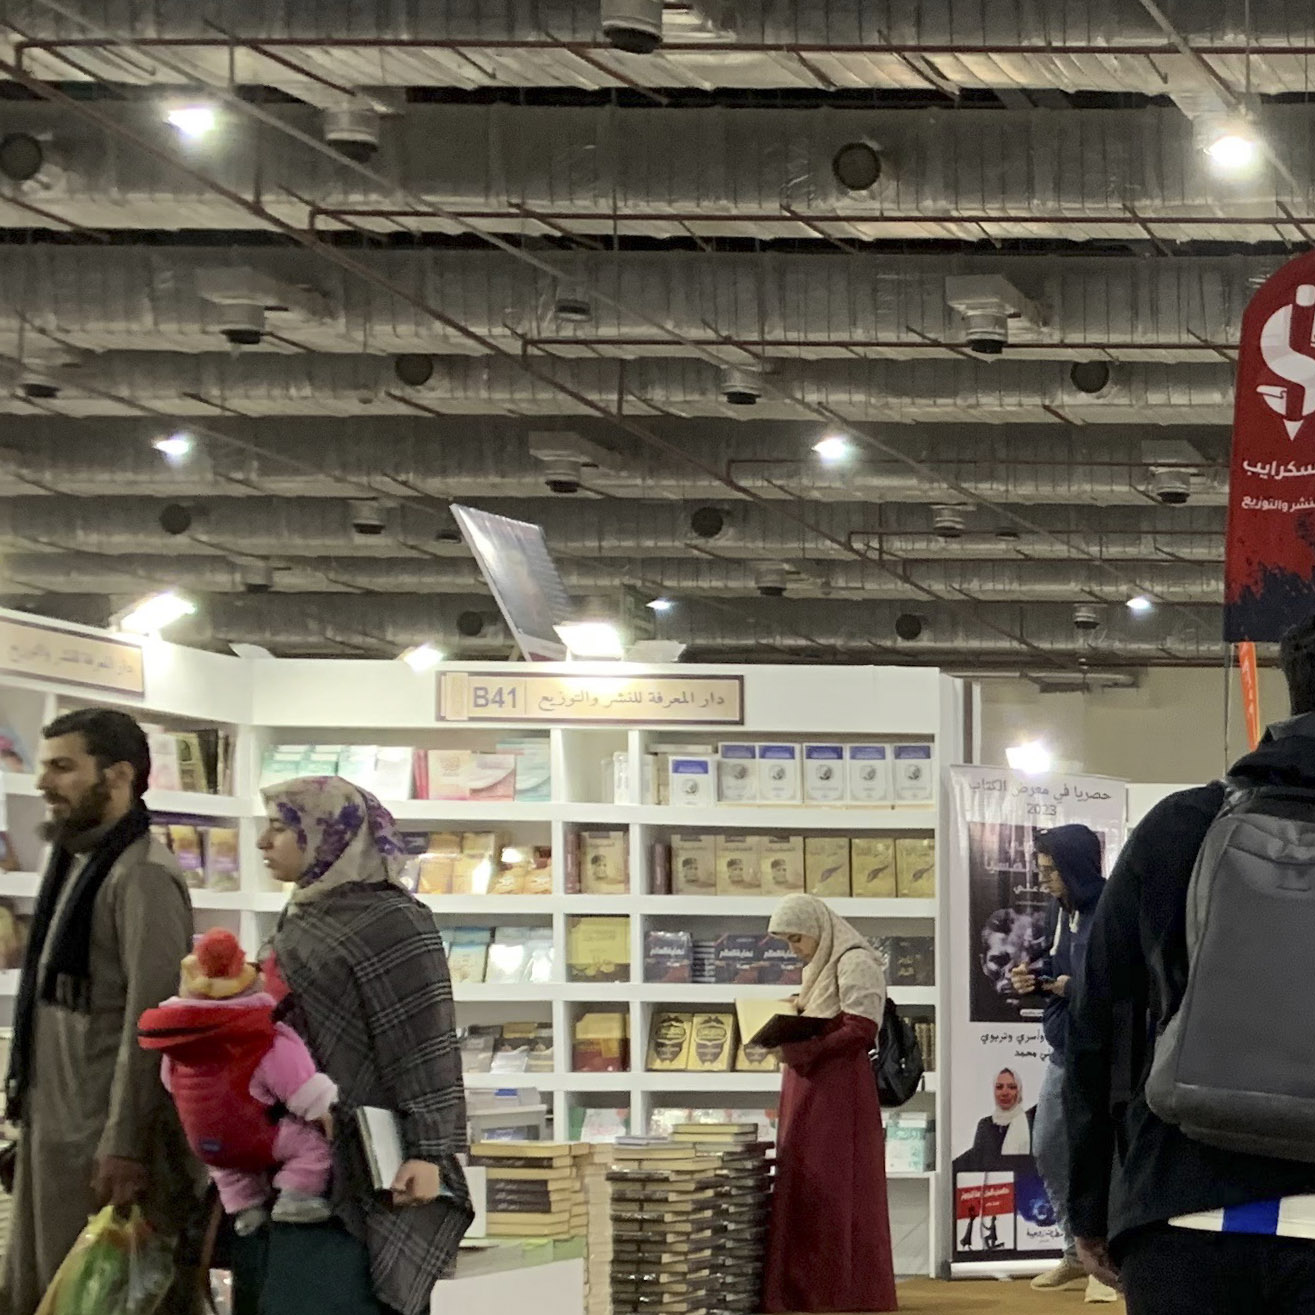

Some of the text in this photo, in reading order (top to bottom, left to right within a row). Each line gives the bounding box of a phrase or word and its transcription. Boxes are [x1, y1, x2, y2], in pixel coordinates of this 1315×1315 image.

[1241, 494, 1290, 513] والتوزيع
[473, 686, 518, 709] B41
[538, 690, 726, 711] دار المعرفة للنشر والتوزيع
[1054, 784, 1070, 804] في
[1074, 786, 1112, 802] حصريا
[1027, 803, 1057, 816] 2023
